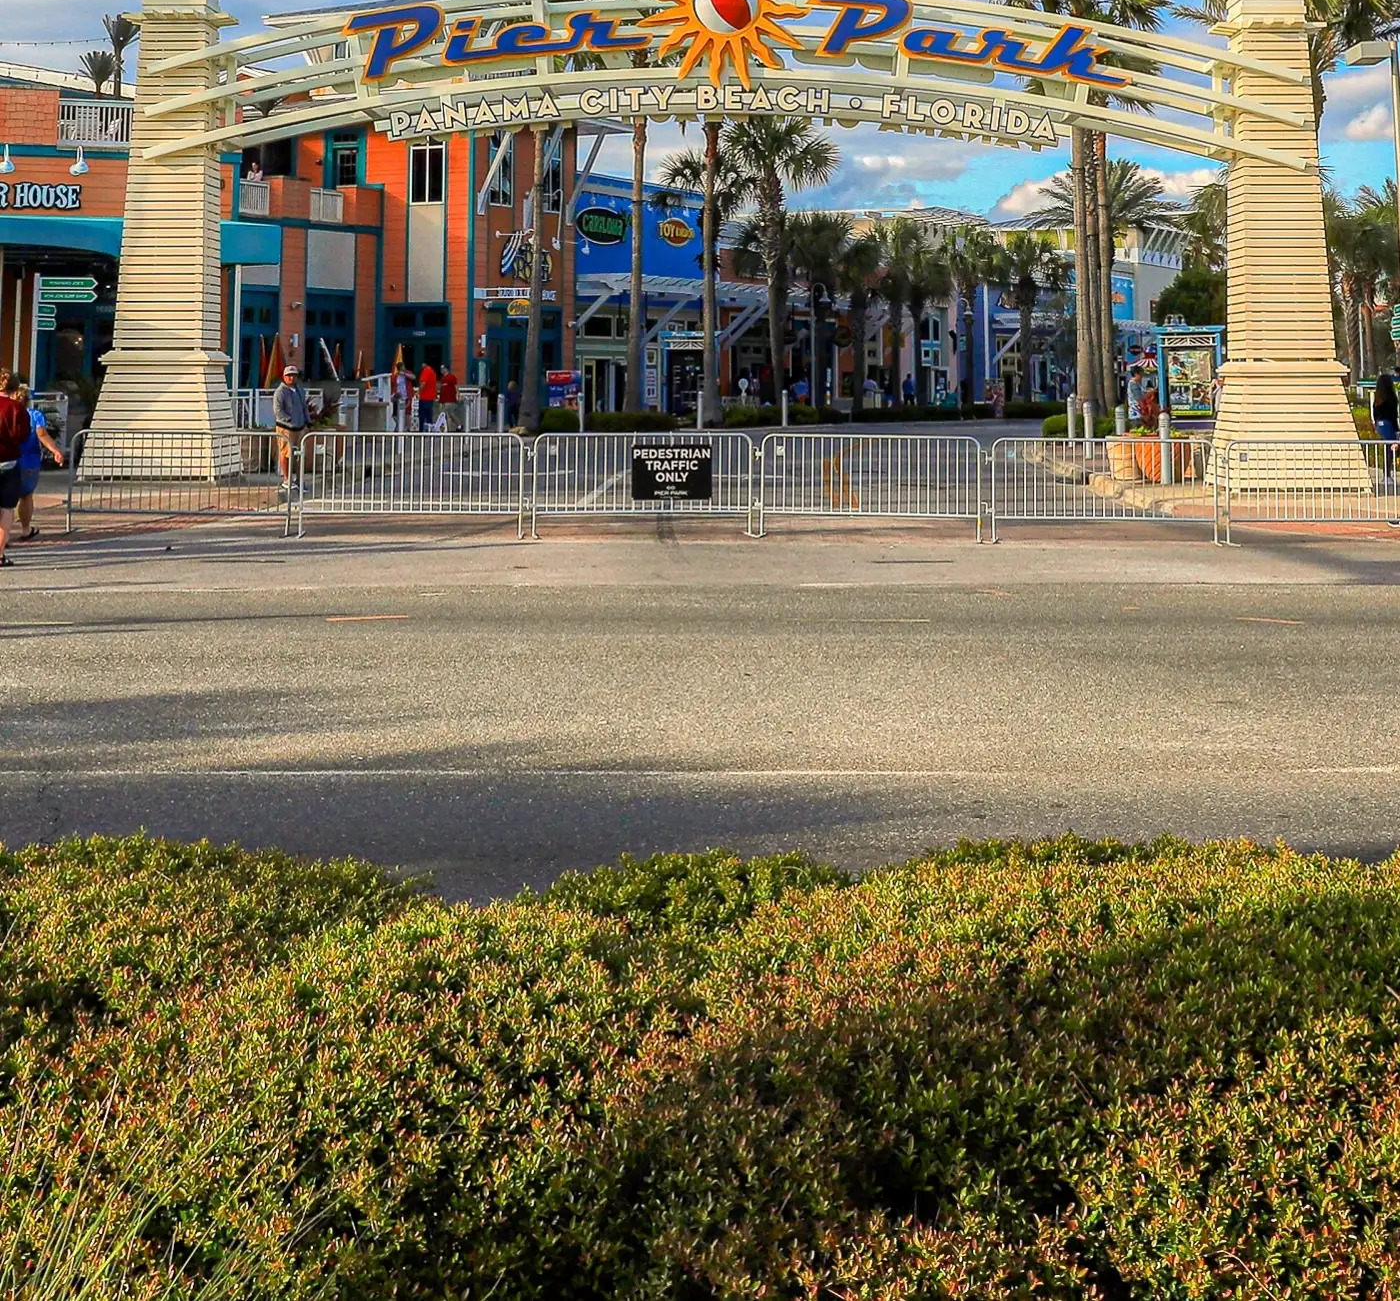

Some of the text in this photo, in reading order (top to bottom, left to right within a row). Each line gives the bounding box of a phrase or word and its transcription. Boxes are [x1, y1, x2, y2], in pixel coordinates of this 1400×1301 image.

[341, 2, 653, 84] Pier
[389, 84, 1057, 142] PANAMA CITY BEACH FLORIDA
[13, 182, 81, 210] HOUSE
[657, 221, 675, 239] TOY
[633, 448, 711, 459] PEDESTRIAN
[645, 460, 699, 471] TRAFFIC
[655, 472, 689, 483] ONLY
